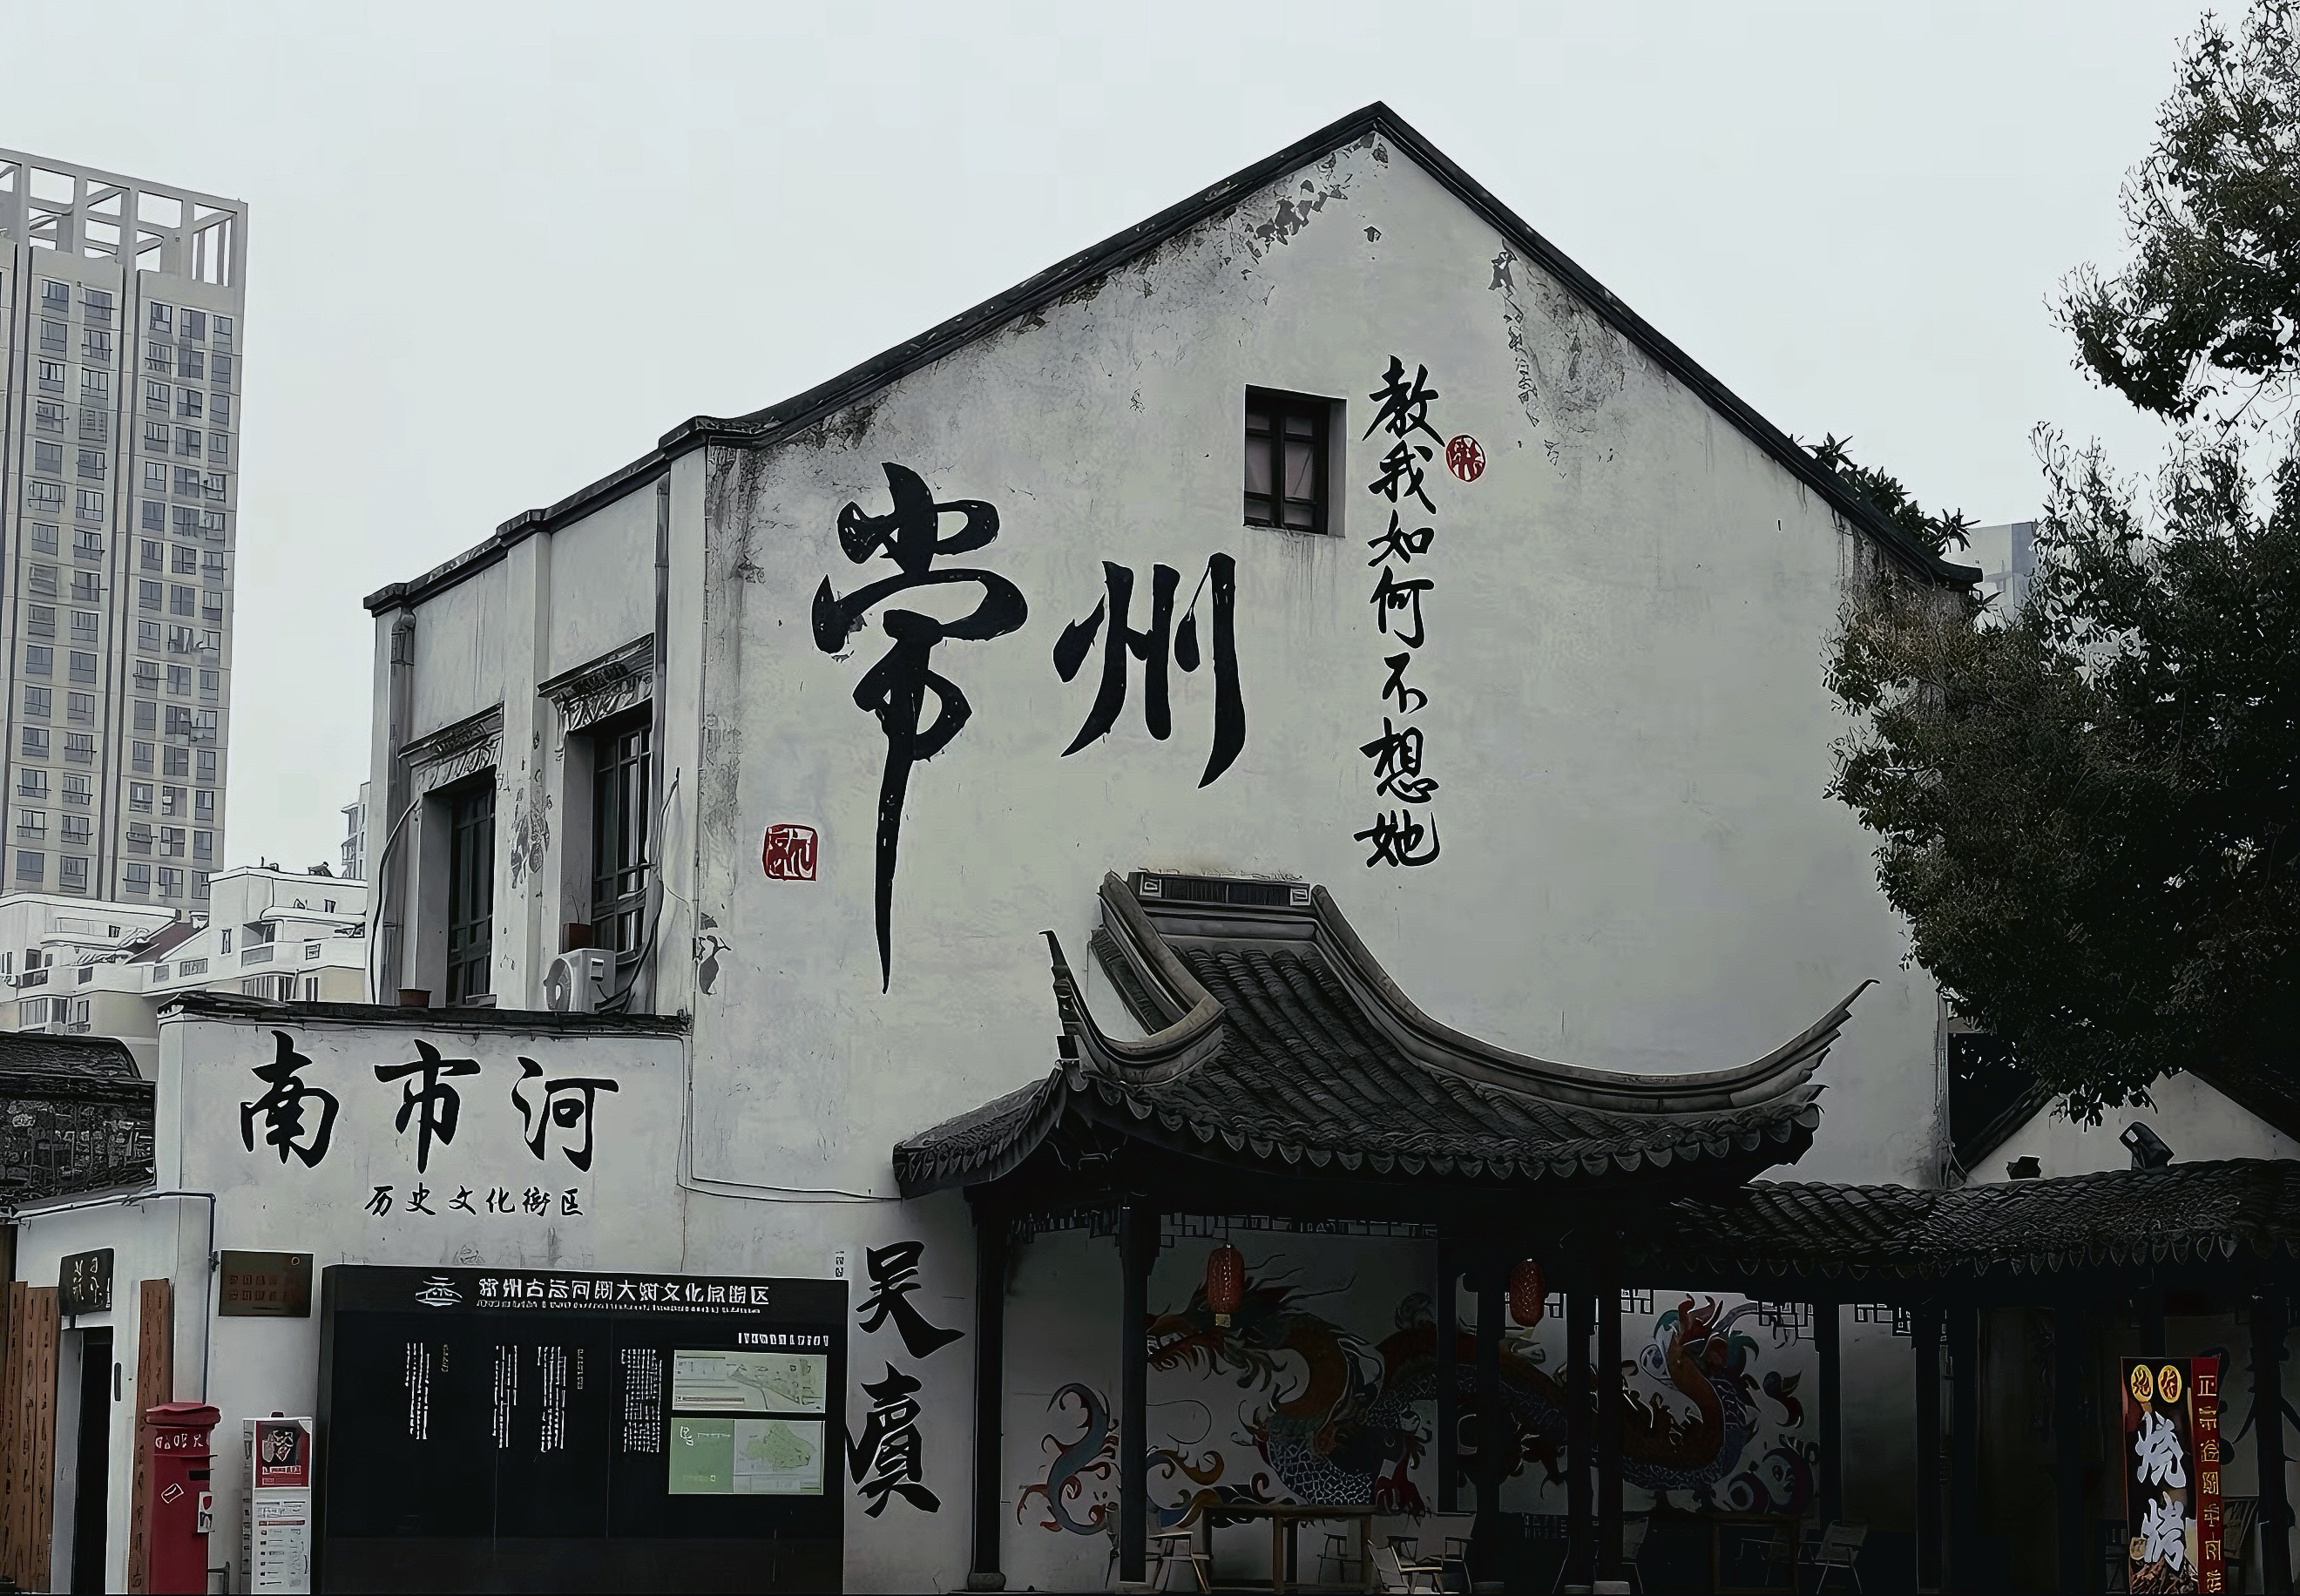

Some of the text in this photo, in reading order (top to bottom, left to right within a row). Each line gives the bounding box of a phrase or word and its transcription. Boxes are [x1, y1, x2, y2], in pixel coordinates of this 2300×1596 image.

[1353, 354, 1446, 869] 教我如何不想她
[811, 461, 1247, 995] 常州
[240, 1030, 619, 1174] 南市河
[363, 1181, 584, 1217] 历史文化街区
[2134, 1410, 2187, 1572] 烧烤
